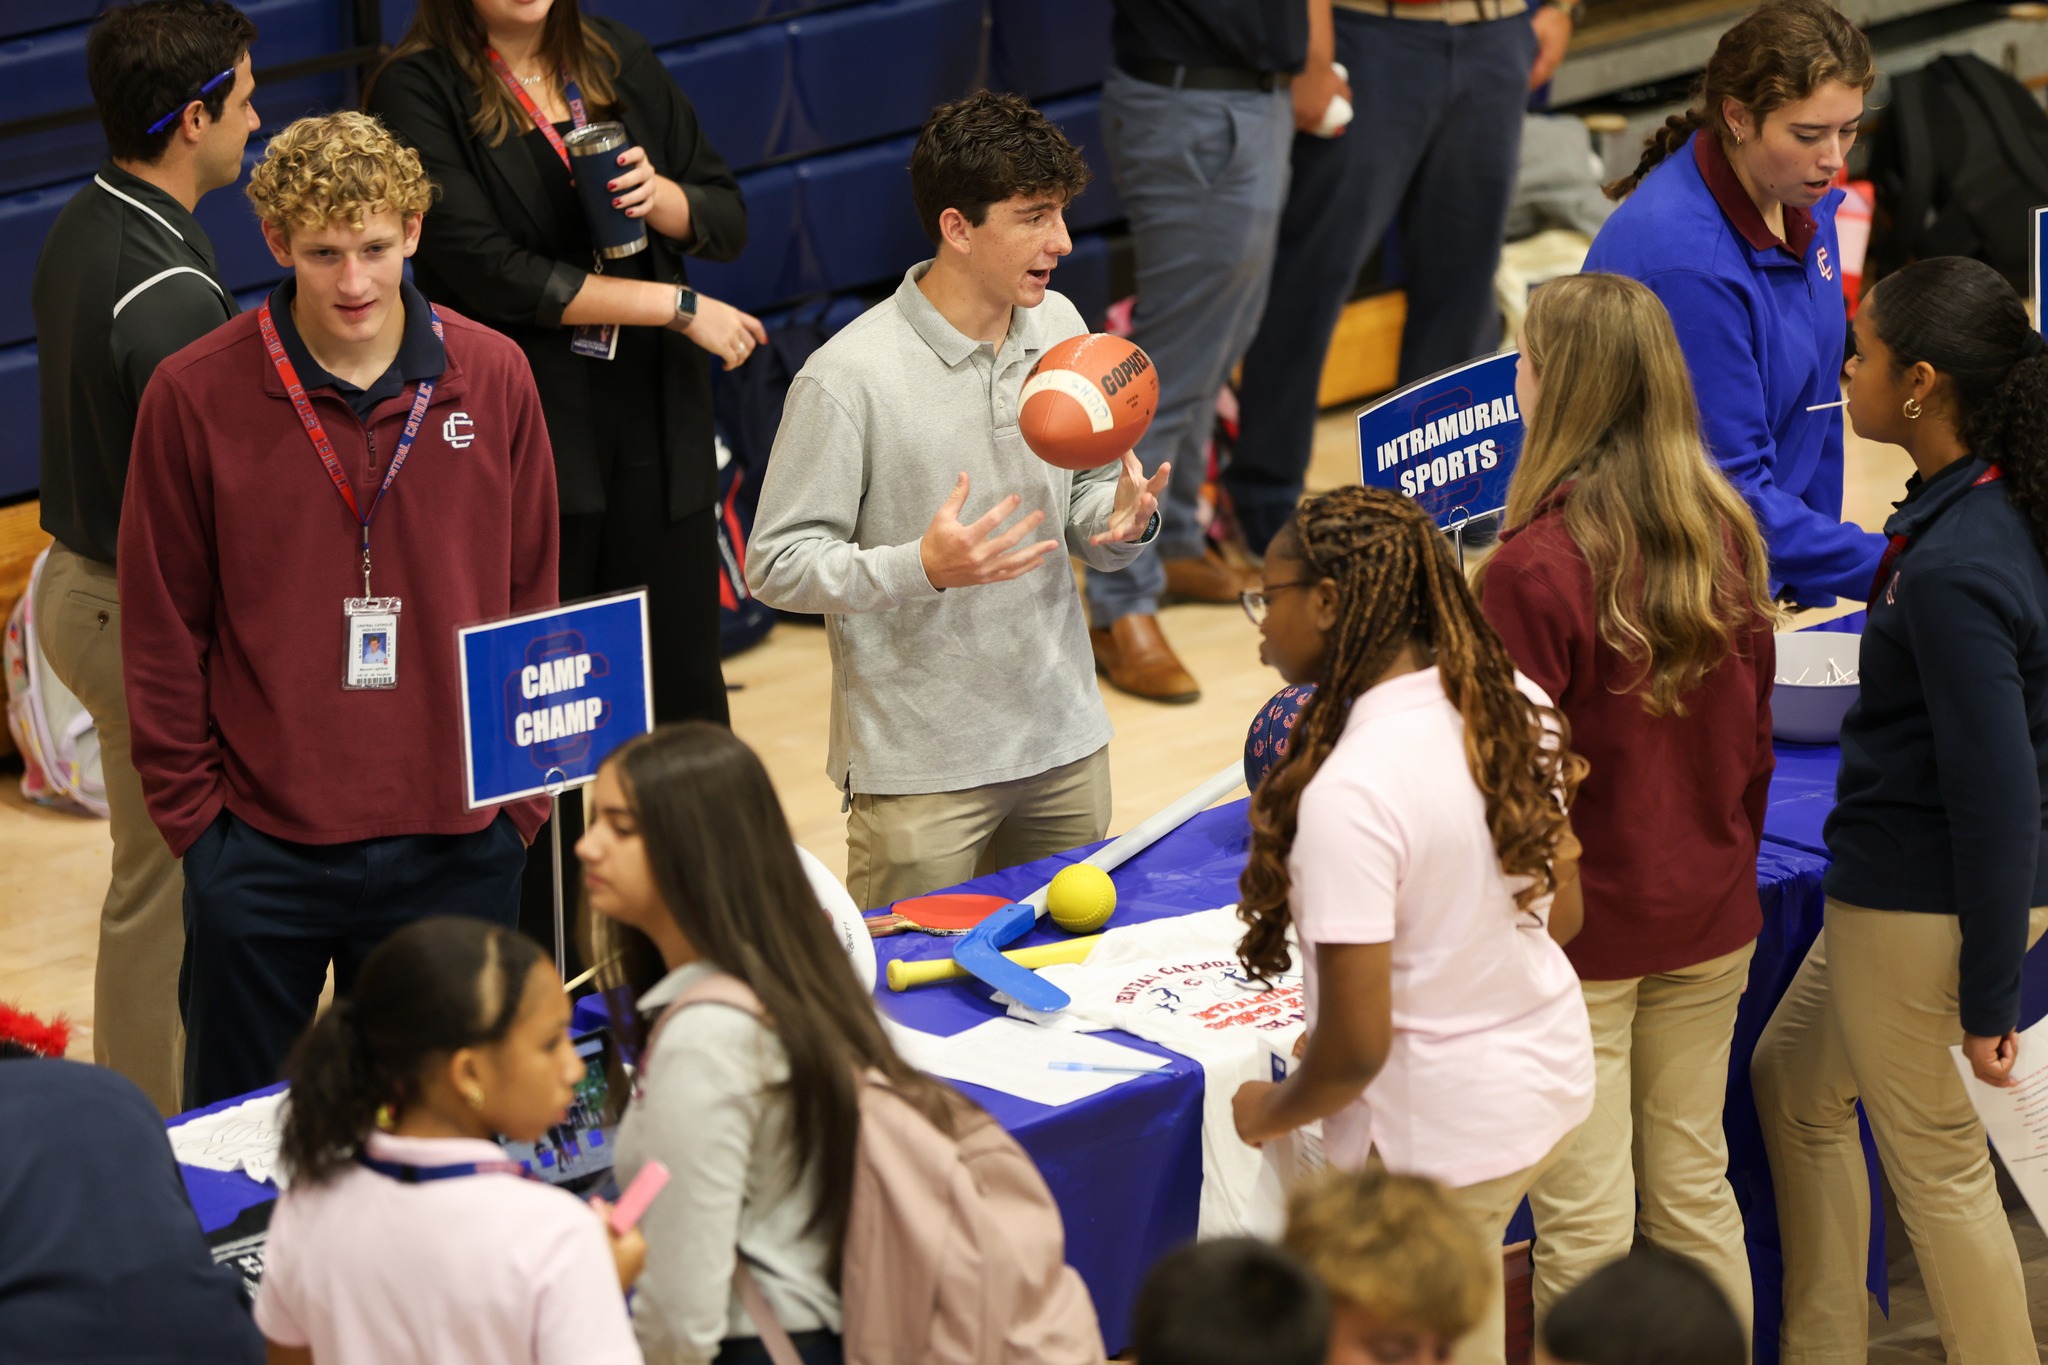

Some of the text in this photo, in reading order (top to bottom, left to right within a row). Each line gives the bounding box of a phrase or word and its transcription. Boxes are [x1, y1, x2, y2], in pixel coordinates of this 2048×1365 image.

[382, 382, 433, 490] CENTRAL CATHOLIC
[1376, 394, 1519, 473] INTRAMURAL
[1400, 439, 1498, 498] SPORTS
[521, 653, 592, 700] CAMP
[515, 696, 602, 747] CHAMP
